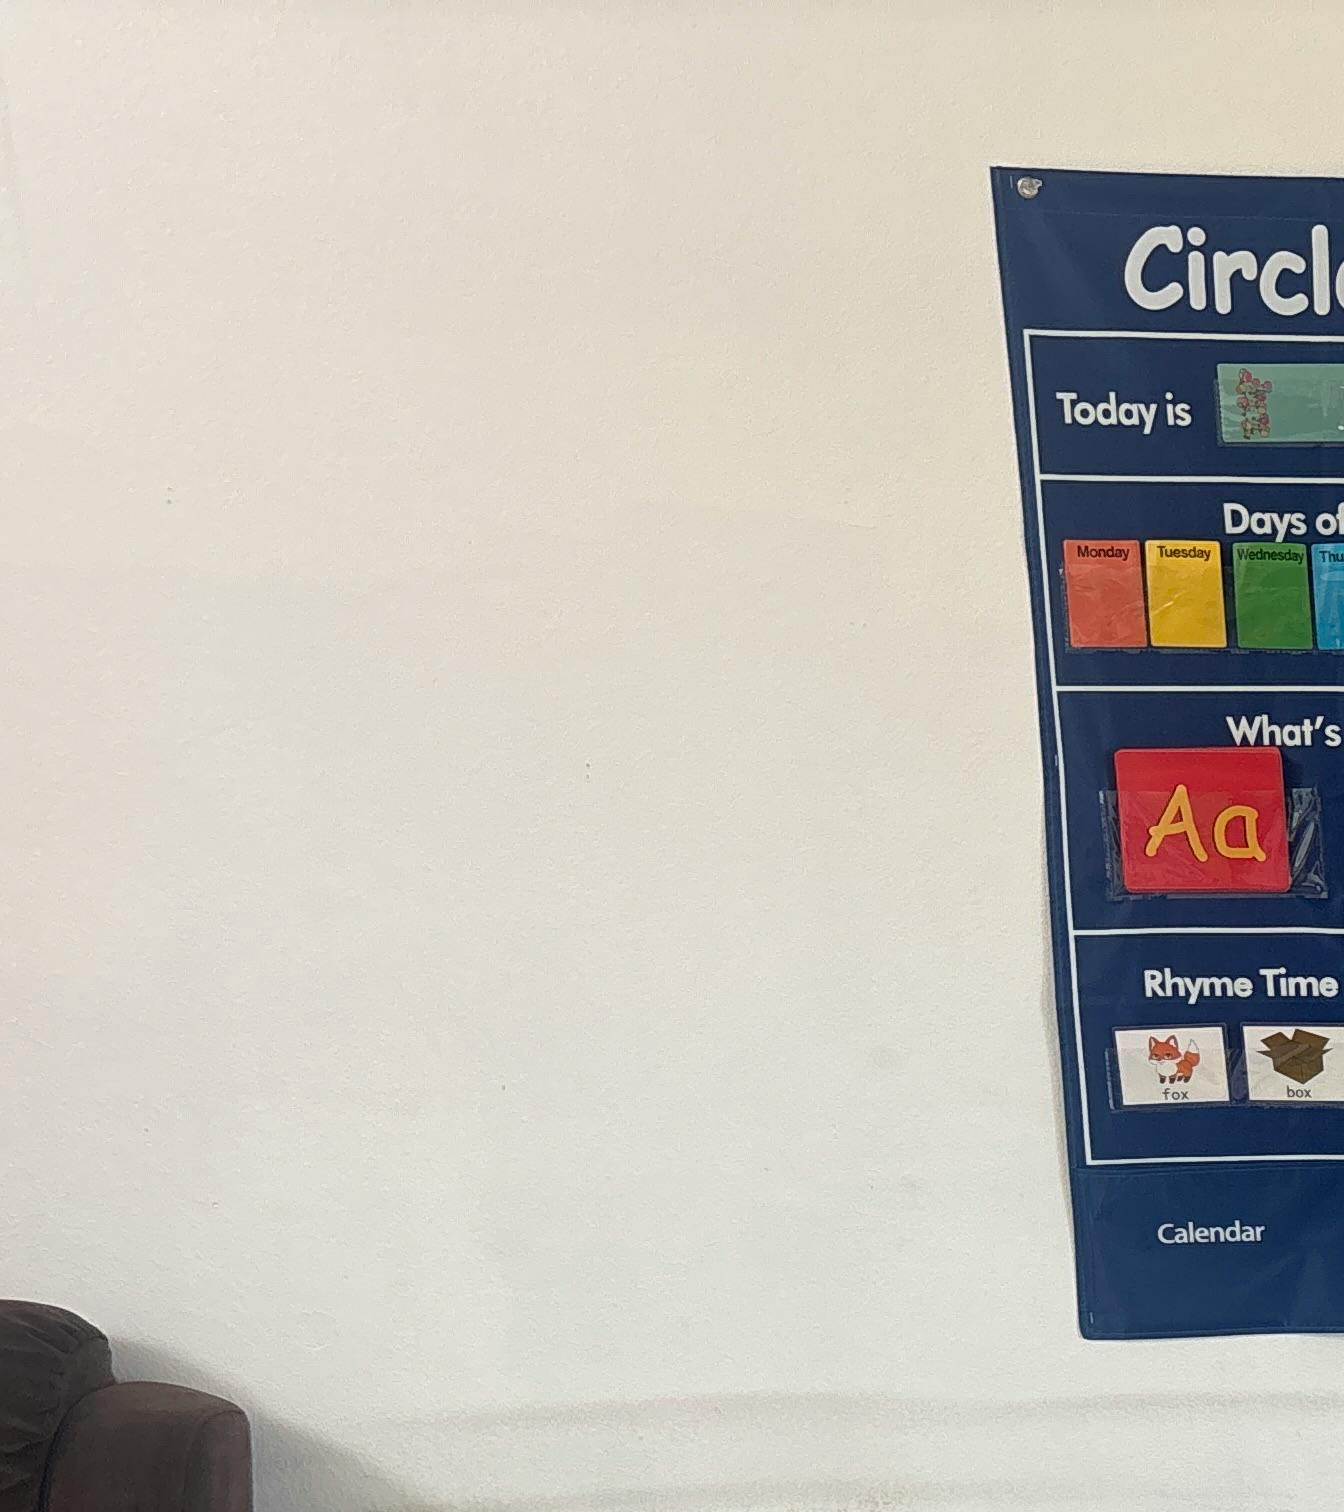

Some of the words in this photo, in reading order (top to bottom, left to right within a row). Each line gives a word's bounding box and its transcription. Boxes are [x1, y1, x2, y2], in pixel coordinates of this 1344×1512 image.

[1055, 392, 1156, 434] Today
[1165, 392, 1192, 427] is
[1223, 503, 1307, 542] Days
[1077, 546, 1131, 563] Monday
[1156, 546, 1212, 564] Tuesday
[1237, 548, 1305, 565] Wednesday
[1226, 715, 1342, 748] What's
[1145, 784, 1268, 864] Aa
[1144, 968, 1253, 1005] Rhyme
[1260, 967, 1340, 999] Time
[1161, 1088, 1189, 1101] fox
[1286, 1085, 1312, 1099] box
[1157, 1222, 1265, 1244] Calendar
